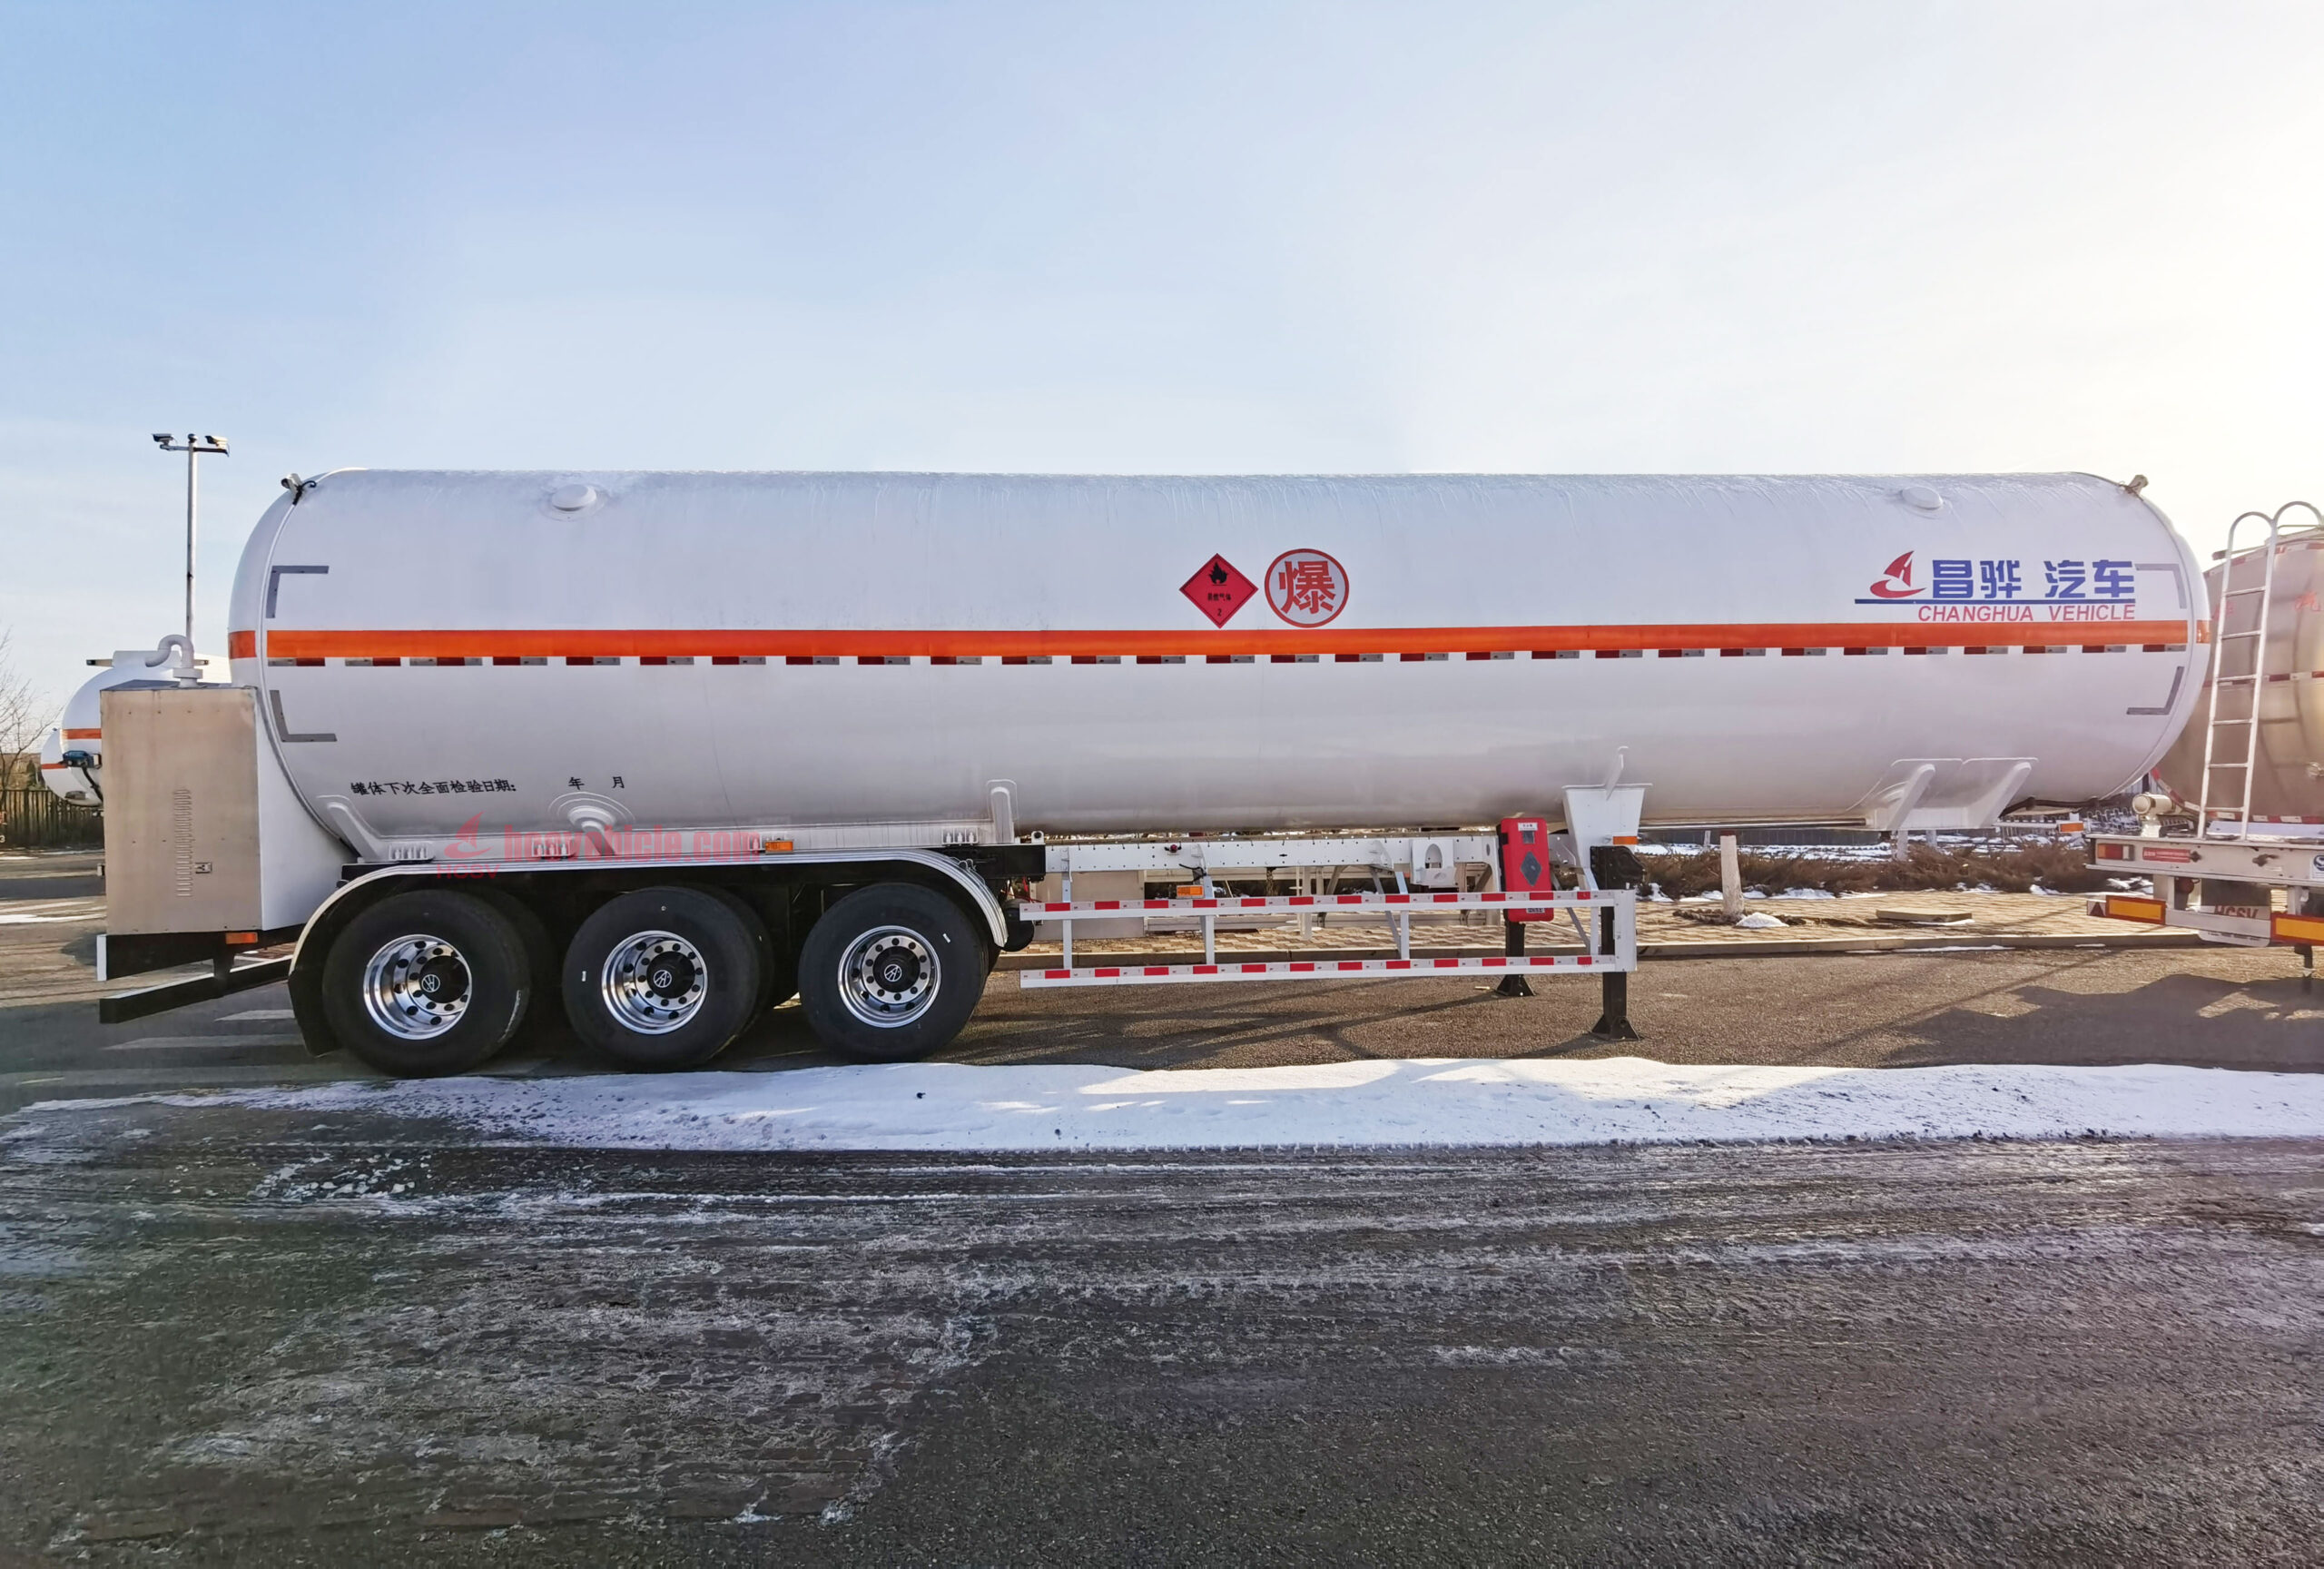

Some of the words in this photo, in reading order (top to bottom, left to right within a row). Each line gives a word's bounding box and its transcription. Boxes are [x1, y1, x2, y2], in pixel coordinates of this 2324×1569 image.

[1932, 559, 2022, 598] 昌骅
[2043, 559, 2135, 598] 汽车
[1278, 560, 1336, 615] 爆
[1217, 608, 1222, 617] 2
[1918, 606, 2034, 622] CHANGHUA
[2049, 605, 2136, 621] VEHICLE
[568, 776, 585, 790] 年
[612, 775, 625, 789] 月
